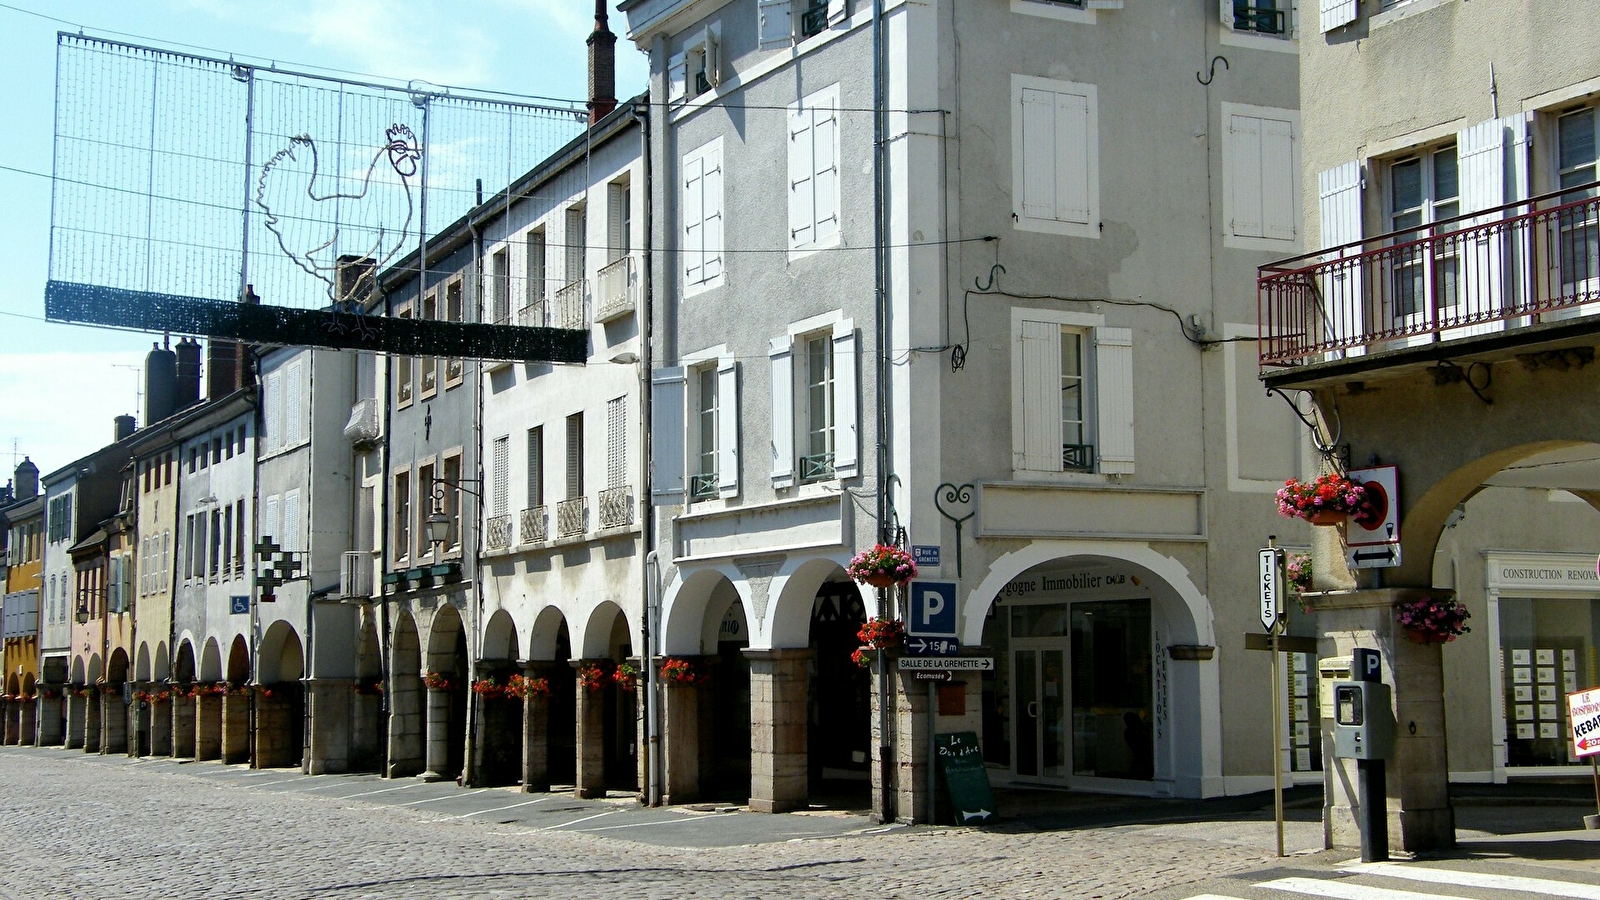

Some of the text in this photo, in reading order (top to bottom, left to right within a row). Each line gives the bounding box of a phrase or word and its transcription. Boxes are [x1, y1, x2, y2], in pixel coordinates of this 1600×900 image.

[1503, 568, 1562, 580] CONSTRUCTION
[1042, 573, 1102, 591] Immobilier
[1263, 555, 1272, 618] TICKETS
[923, 591, 945, 625] P
[901, 660, 978, 668] SALLE DE LA GRENETTE
[1367, 654, 1379, 675] P
[1582, 693, 1591, 703] LE
[950, 735, 962, 746] Le
